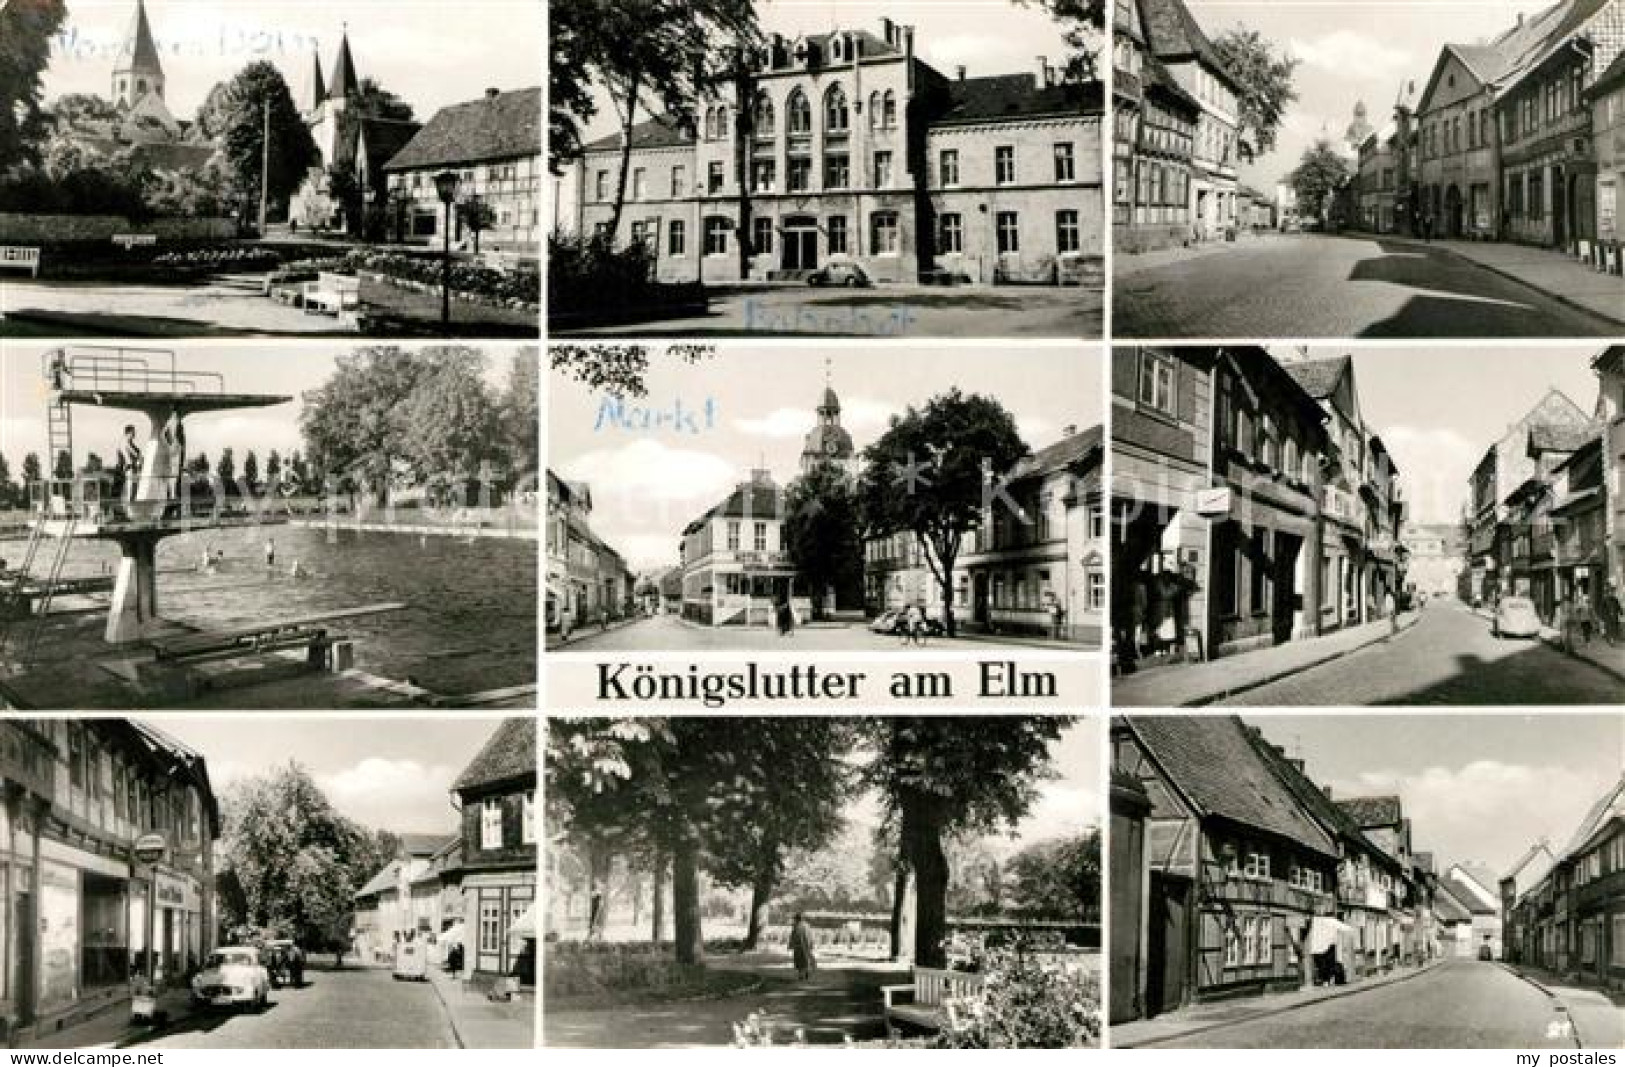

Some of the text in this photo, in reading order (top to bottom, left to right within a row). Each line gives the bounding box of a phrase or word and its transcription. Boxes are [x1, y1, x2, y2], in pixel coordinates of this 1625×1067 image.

[594, 395, 715, 434] Markt
[596, 660, 1059, 708] Königslutter am Elm
